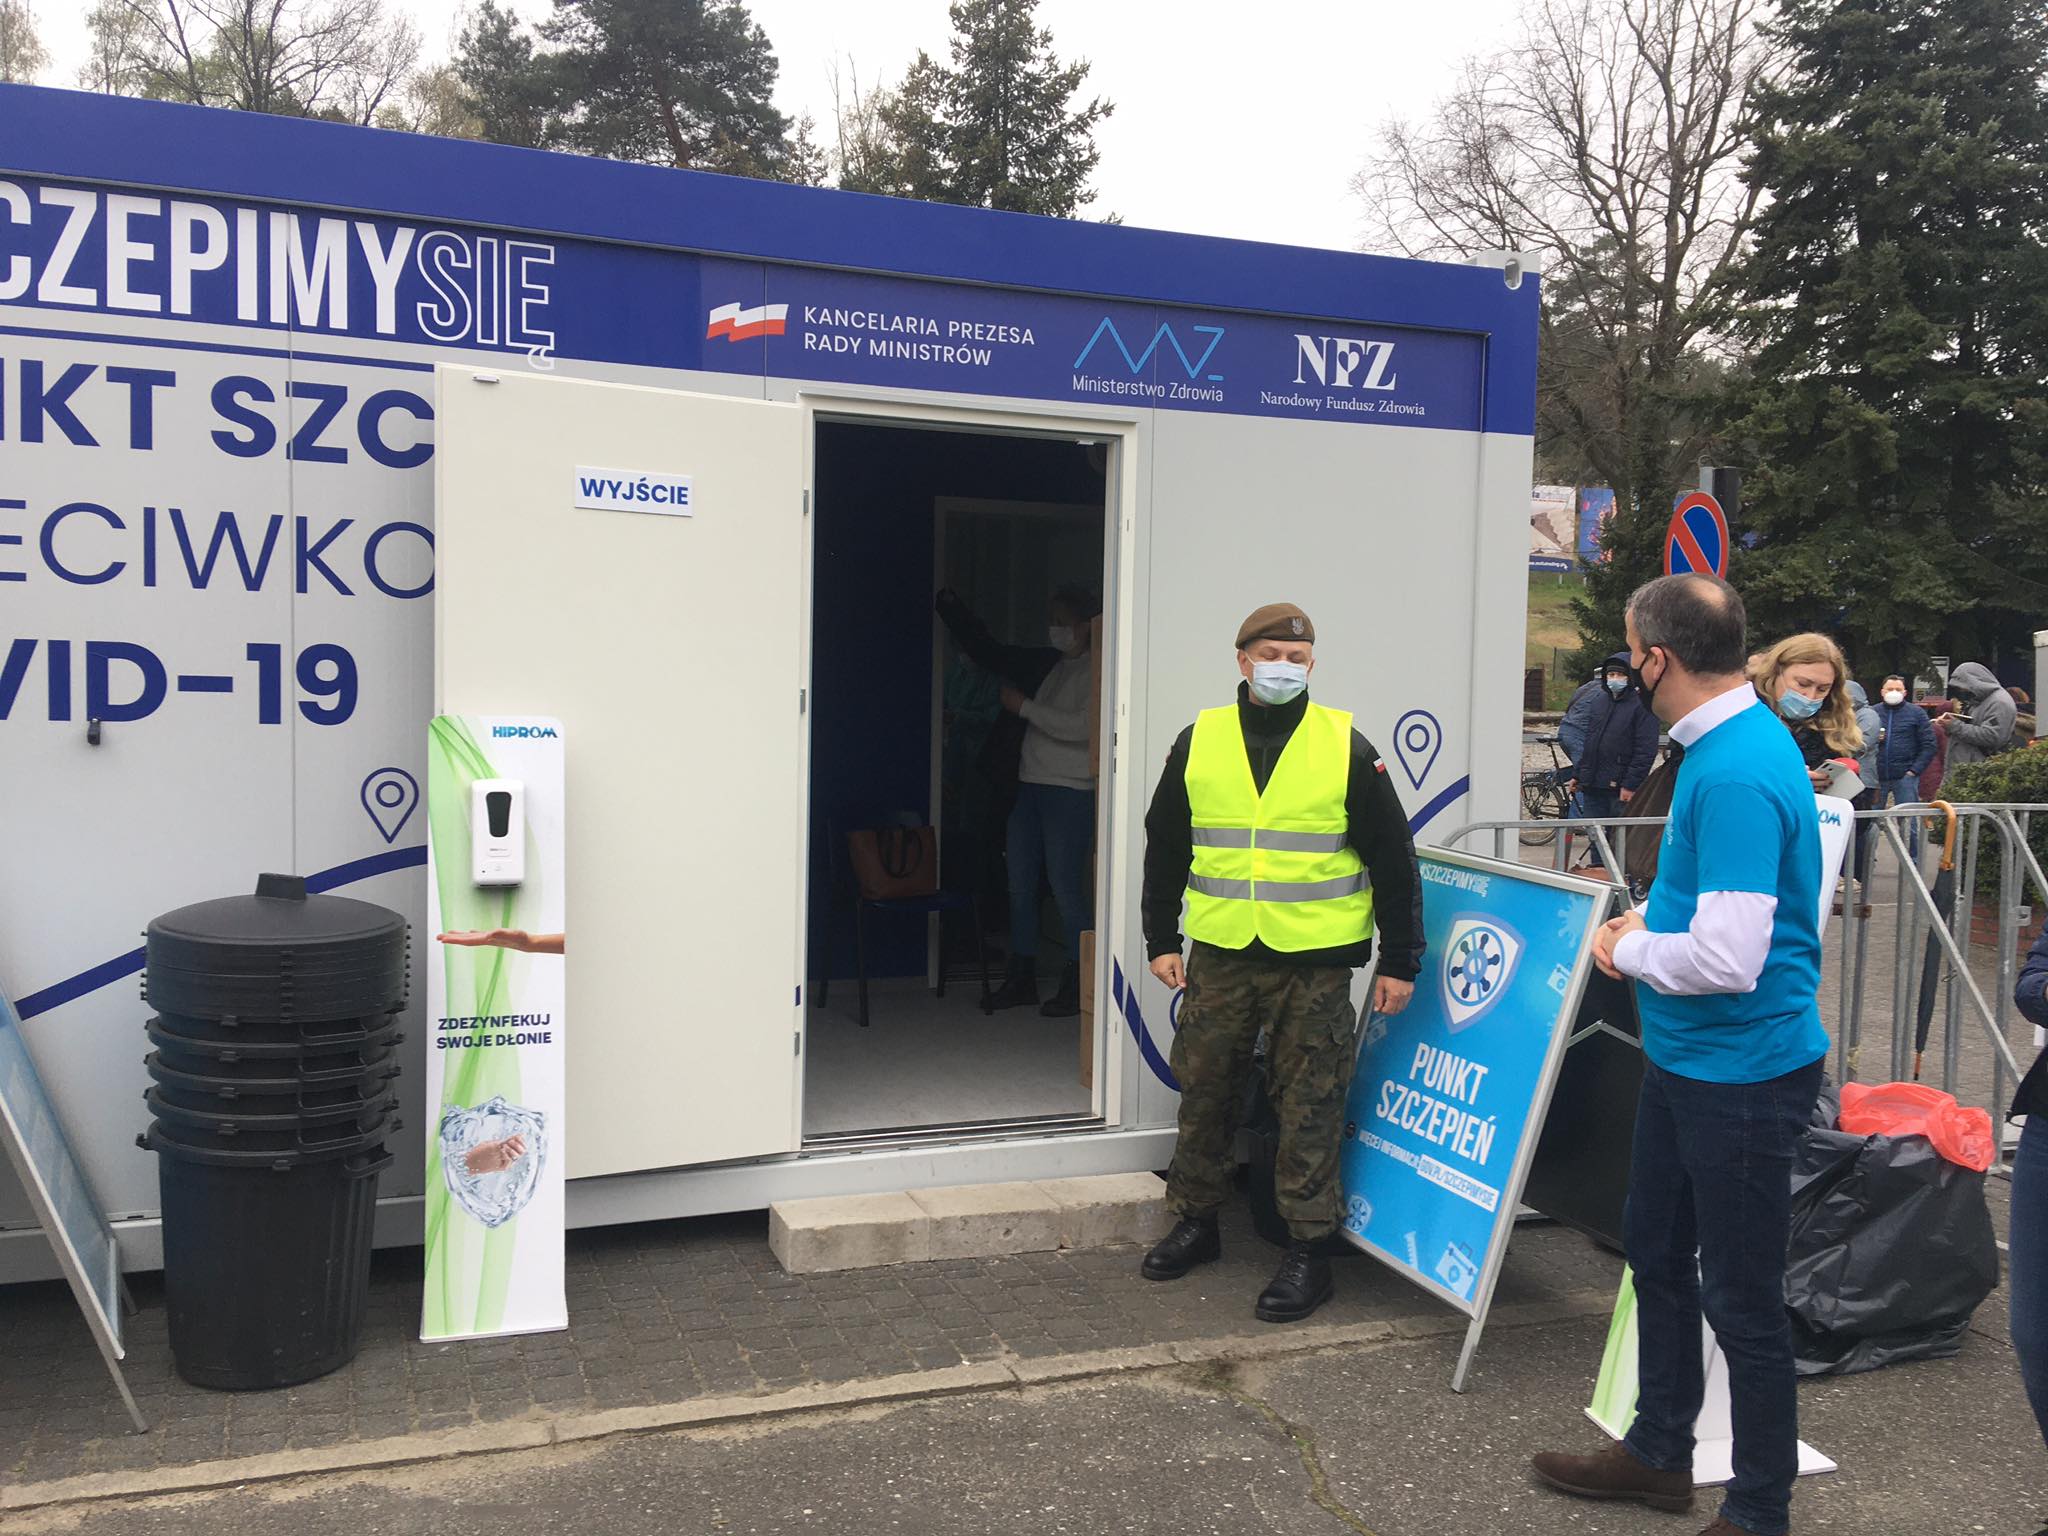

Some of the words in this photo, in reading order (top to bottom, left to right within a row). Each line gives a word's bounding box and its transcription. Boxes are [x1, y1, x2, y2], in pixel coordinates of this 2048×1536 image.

[804, 306, 939, 336] KANCELARIA
[948, 320, 1035, 345] PREZESA
[804, 333, 861, 354] RADY
[870, 340, 991, 366] MINISTRÓW
[1292, 334, 1397, 391] NFZ
[1073, 374, 1165, 397] Ministerstwo
[1169, 382, 1223, 402] Zdrowia
[1260, 391, 1322, 411] Narodowy
[1326, 396, 1375, 412] Fundusz
[1378, 400, 1425, 415] Zdrowia
[0, 357, 176, 450] KT
[211, 375, 434, 468] SZC
[580, 477, 688, 505] WYJŚCIE
[493, 726, 558, 738] HIPROM
[438, 1014, 550, 1030] ZDEZYNFEKUJ
[437, 1035, 492, 1049] SWOJE
[495, 1032, 552, 1045] DŁONIE
[1409, 1042, 1488, 1105] PUNKT
[1376, 1080, 1496, 1166] SZCZEPIEŃ
